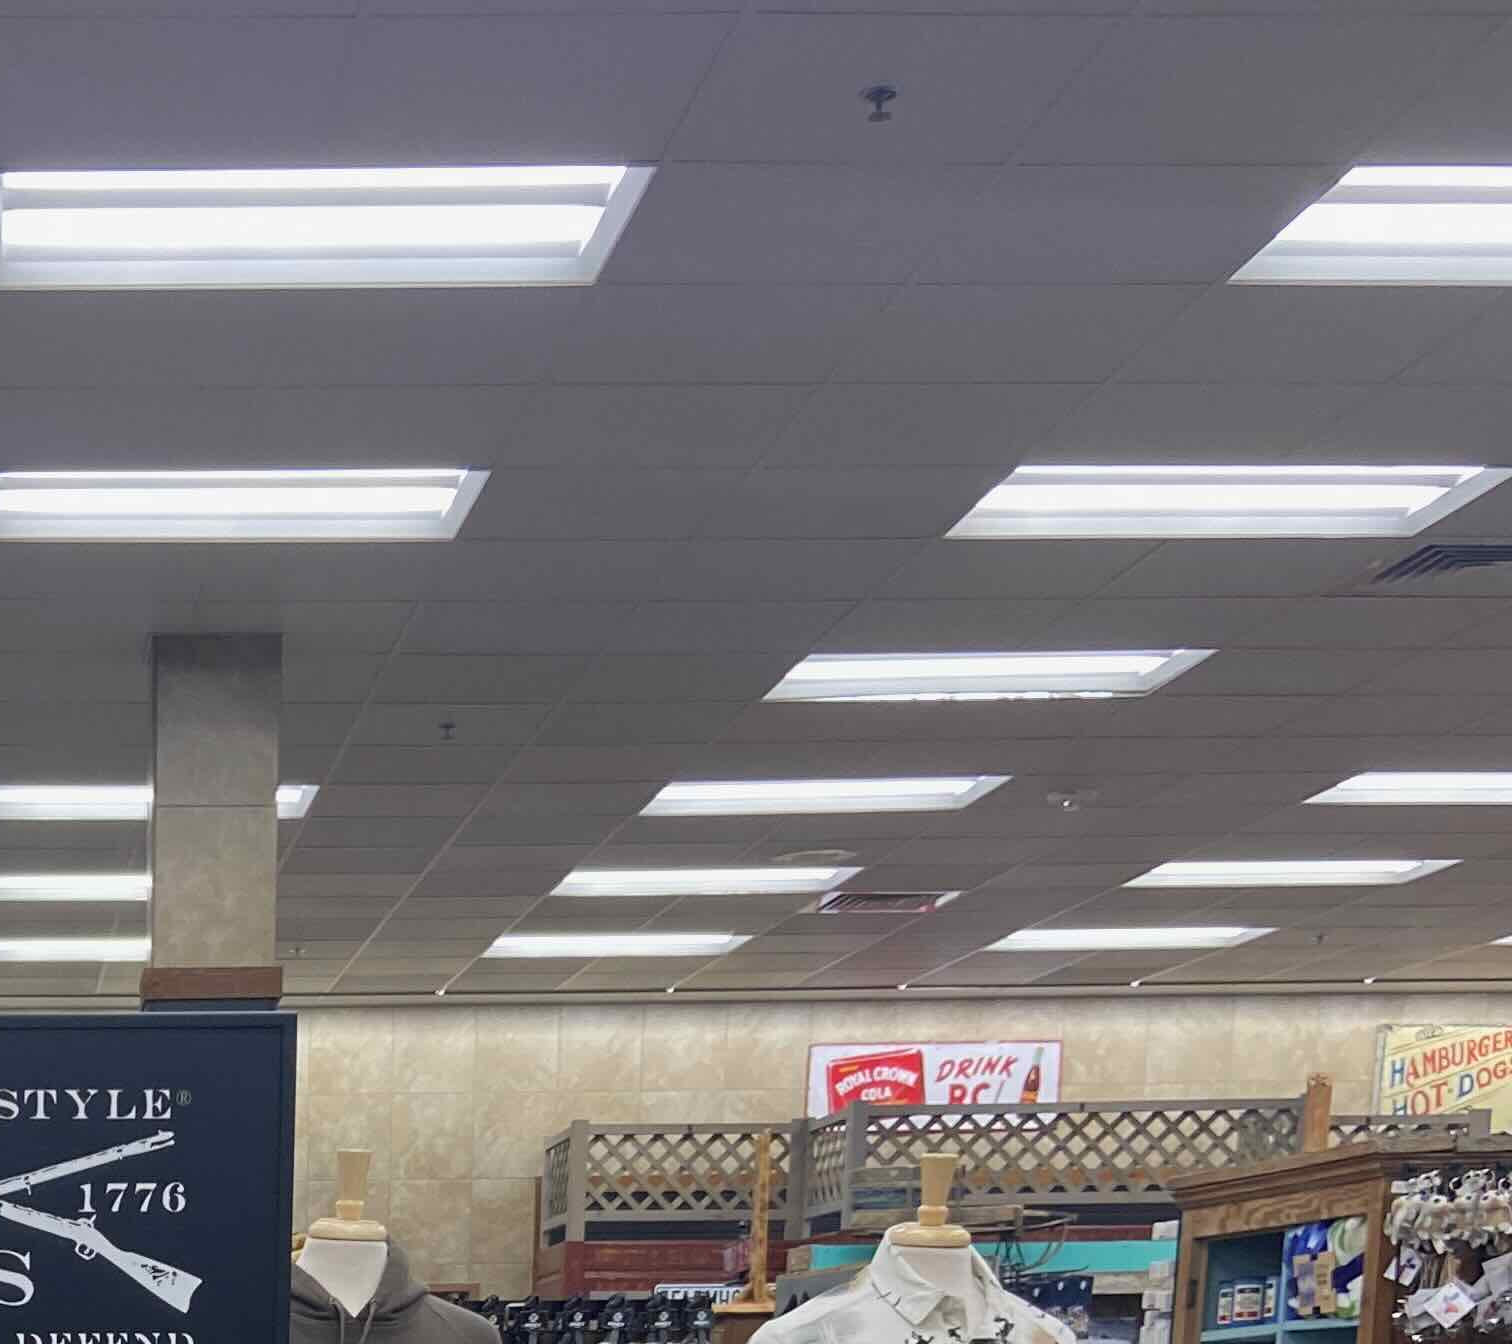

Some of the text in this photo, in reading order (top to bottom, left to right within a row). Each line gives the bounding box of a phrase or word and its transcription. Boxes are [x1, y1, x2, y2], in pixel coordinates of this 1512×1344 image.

[835, 1066, 919, 1097] ROYAL CROWN
[936, 1056, 1019, 1083] DRINK
[861, 1086, 893, 1101] COLA
[78, 1182, 186, 1213] 1776
